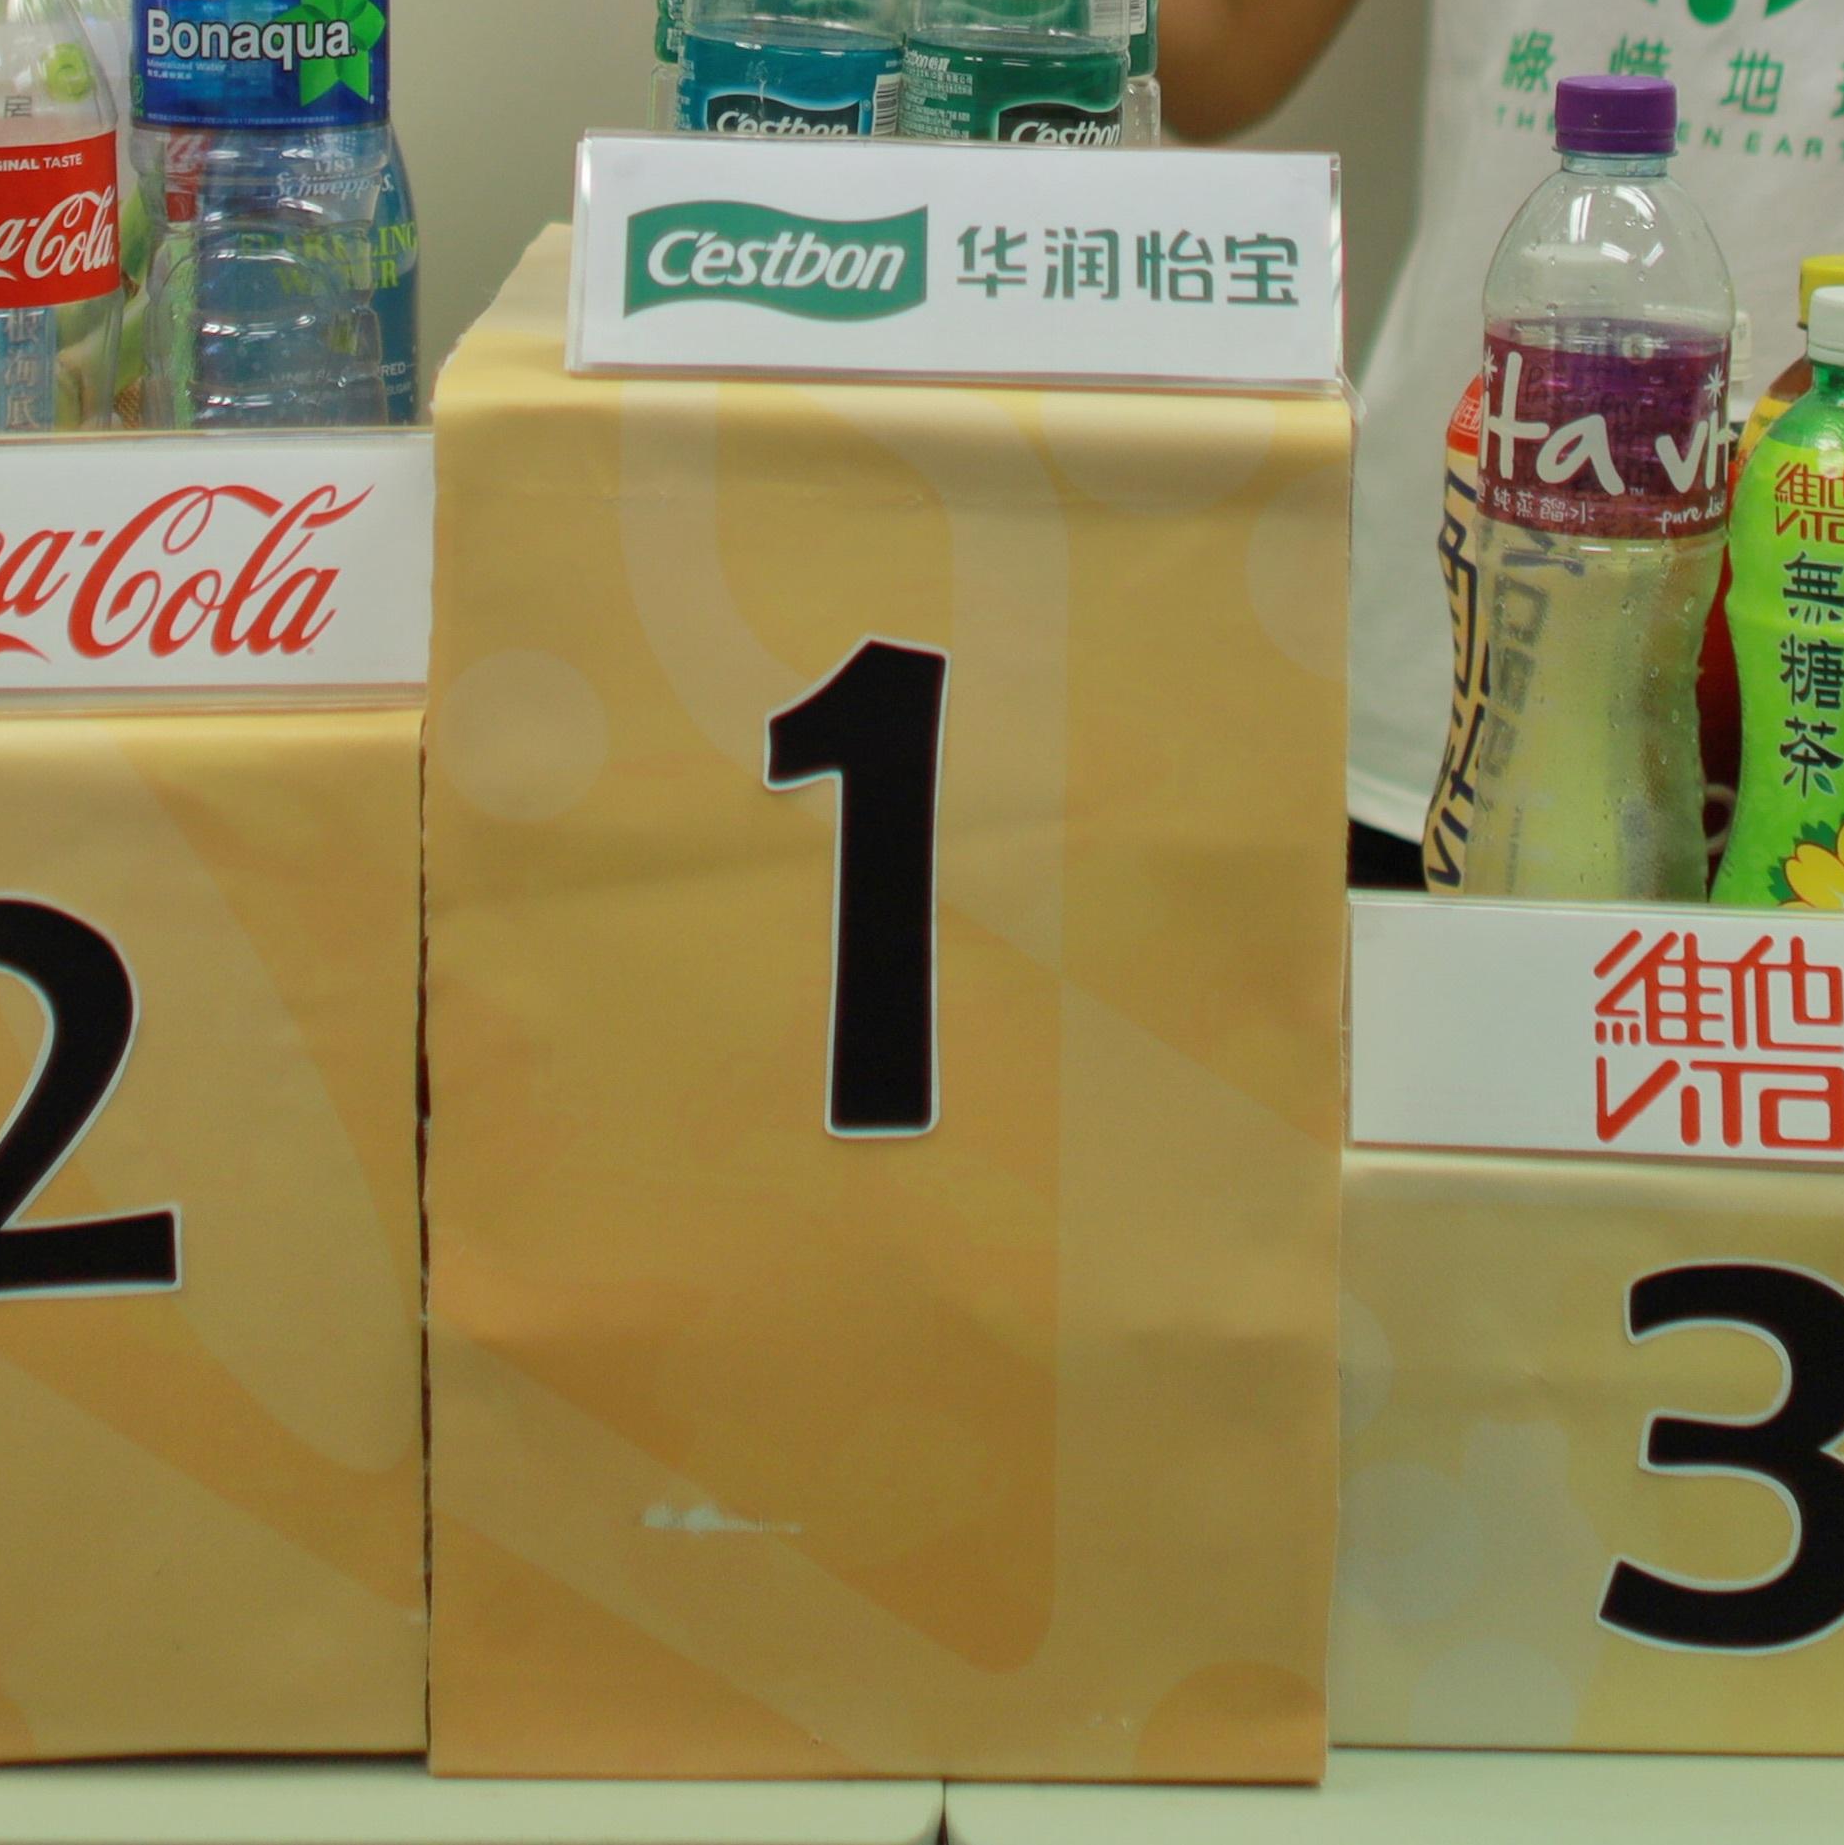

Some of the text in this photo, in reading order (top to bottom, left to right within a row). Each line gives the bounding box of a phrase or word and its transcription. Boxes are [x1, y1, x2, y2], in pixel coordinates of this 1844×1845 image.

[147, 8, 351, 71] Bonaqua
[43, 152, 83, 170] TASTE
[956, 224, 1301, 308] 华润怡宝
[767, 638, 947, 1133] 1
